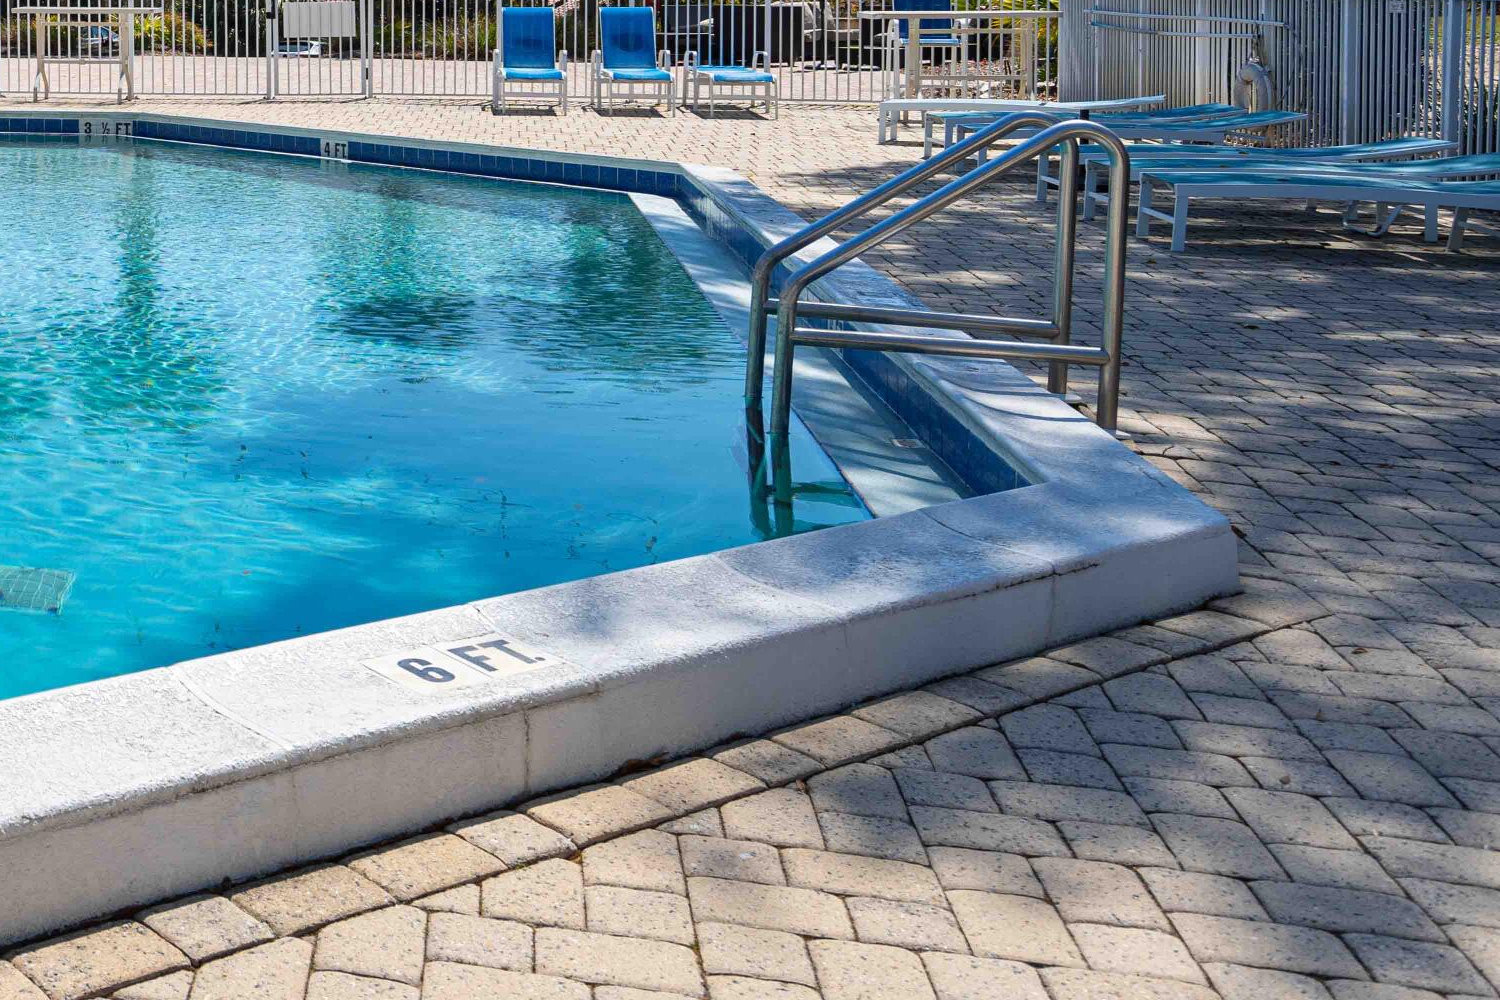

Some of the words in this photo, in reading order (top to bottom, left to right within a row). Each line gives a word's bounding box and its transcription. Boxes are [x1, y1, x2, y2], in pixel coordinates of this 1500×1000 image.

[83, 121, 92, 134] 3
[324, 142, 331, 157] 4
[396, 658, 456, 683] 6
[447, 639, 546, 672] FT.
